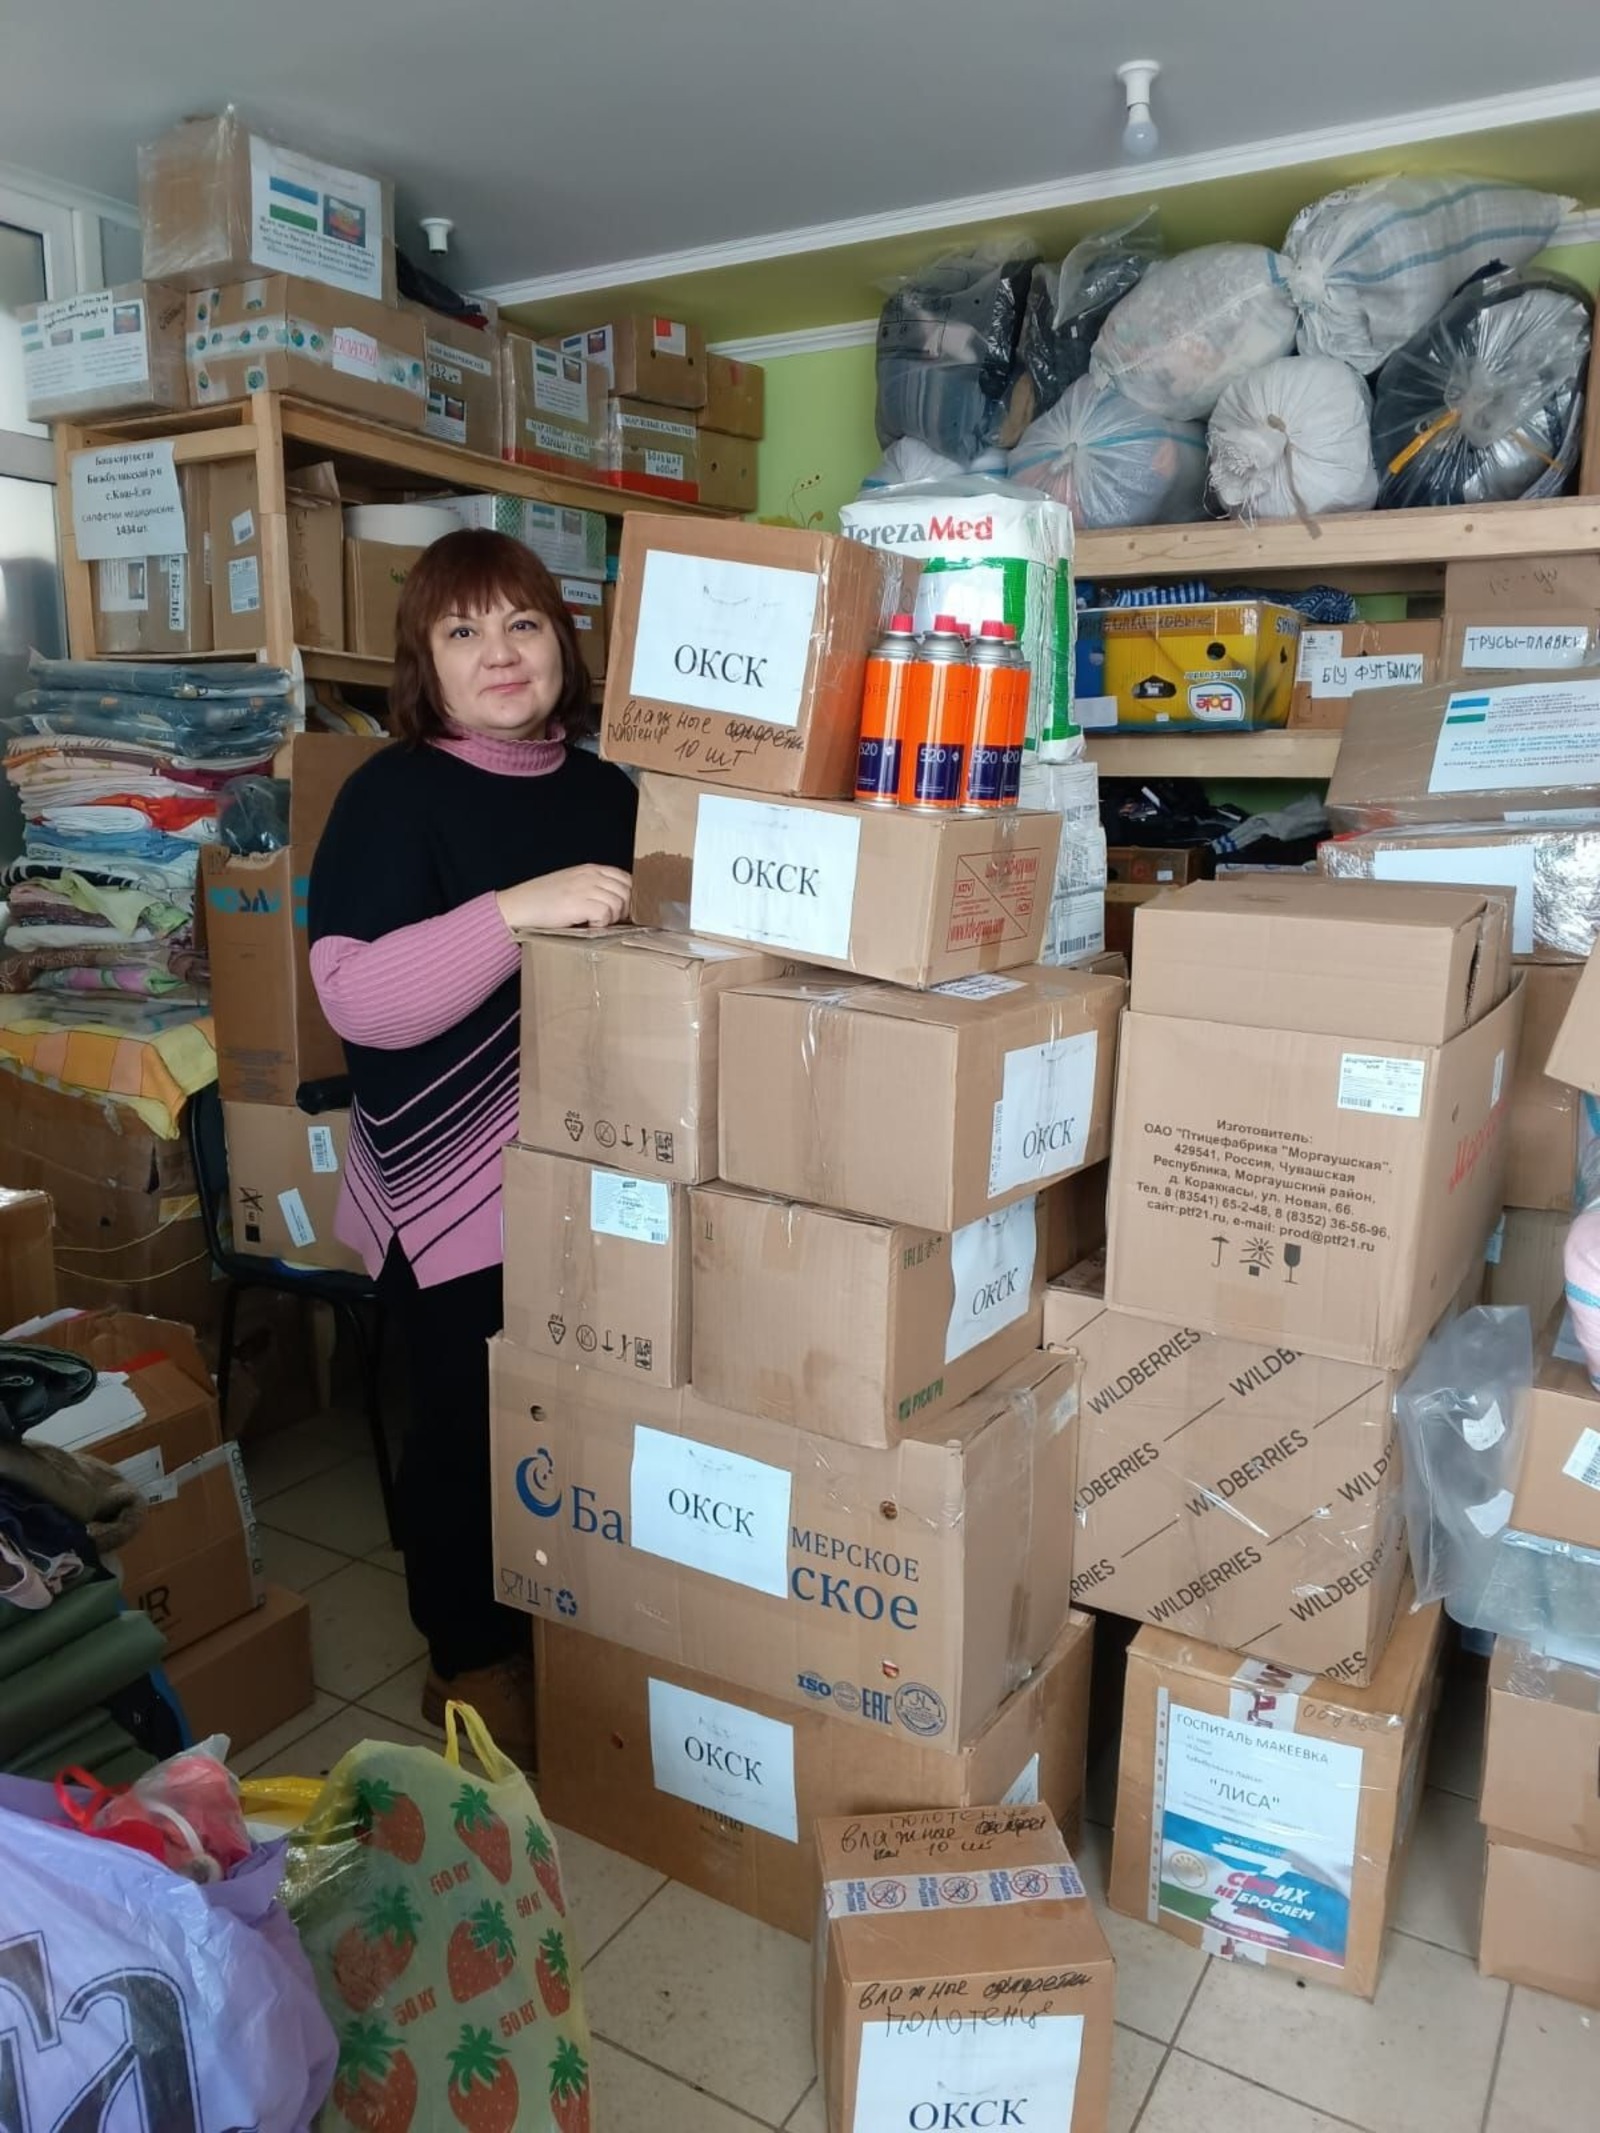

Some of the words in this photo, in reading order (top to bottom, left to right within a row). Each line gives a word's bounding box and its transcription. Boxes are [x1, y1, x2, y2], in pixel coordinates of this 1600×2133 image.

[843, 515, 993, 545] TerezaMed
[674, 644, 768, 688] ОКСК
[1355, 660, 1422, 681] ФУТБОЛКИ
[1196, 695, 1233, 713] Dole
[674, 739, 700, 762] 10
[919, 748, 946, 763] 520
[972, 751, 998, 765] 520
[732, 855, 820, 898] ОКСК
[1022, 1116, 1075, 1159] ОКСК
[1144, 1122, 1173, 1138] ОАО
[1216, 1119, 1313, 1144] Изготовитель:
[1234, 1168, 1326, 1194] Моргаушский
[1279, 1160, 1356, 1184] Чувашская
[1164, 1186, 1172, 1197] 8
[1174, 1188, 1219, 1209] (83541)
[1274, 1208, 1283, 1219] 8
[1285, 1209, 1327, 1229] (8352)
[1279, 1226, 1376, 1253] prod@ptf21.ru
[971, 1267, 1019, 1316] ОКСК
[1086, 1326, 1202, 1416] WILDBERRIES
[1228, 1347, 1305, 1398] WILDB
[1073, 1441, 1160, 1512] LDBERRIES
[570, 1484, 625, 1545] Ба
[668, 1487, 756, 1538] ОКСК
[790, 1525, 922, 1584] МЕРСКОЕ
[790, 1566, 919, 1631] ское
[1146, 1545, 1263, 1624] WILDBERRIES
[796, 1673, 832, 1697] ISO
[1176, 1713, 1253, 1746] ГОСПИТАЛЬ
[1255, 1737, 1330, 1765] МАКЕЕВКА
[684, 1735, 764, 1786] ОКСК
[1209, 1778, 1280, 1810] "ЛИСА"
[928, 1841, 949, 1857] 10
[1214, 1884, 1239, 1900] НЕ
[1236, 1892, 1317, 1921] БРОСАЕМ
[499, 2010, 522, 2038] 50
[909, 2097, 1029, 2133] ОКСК
